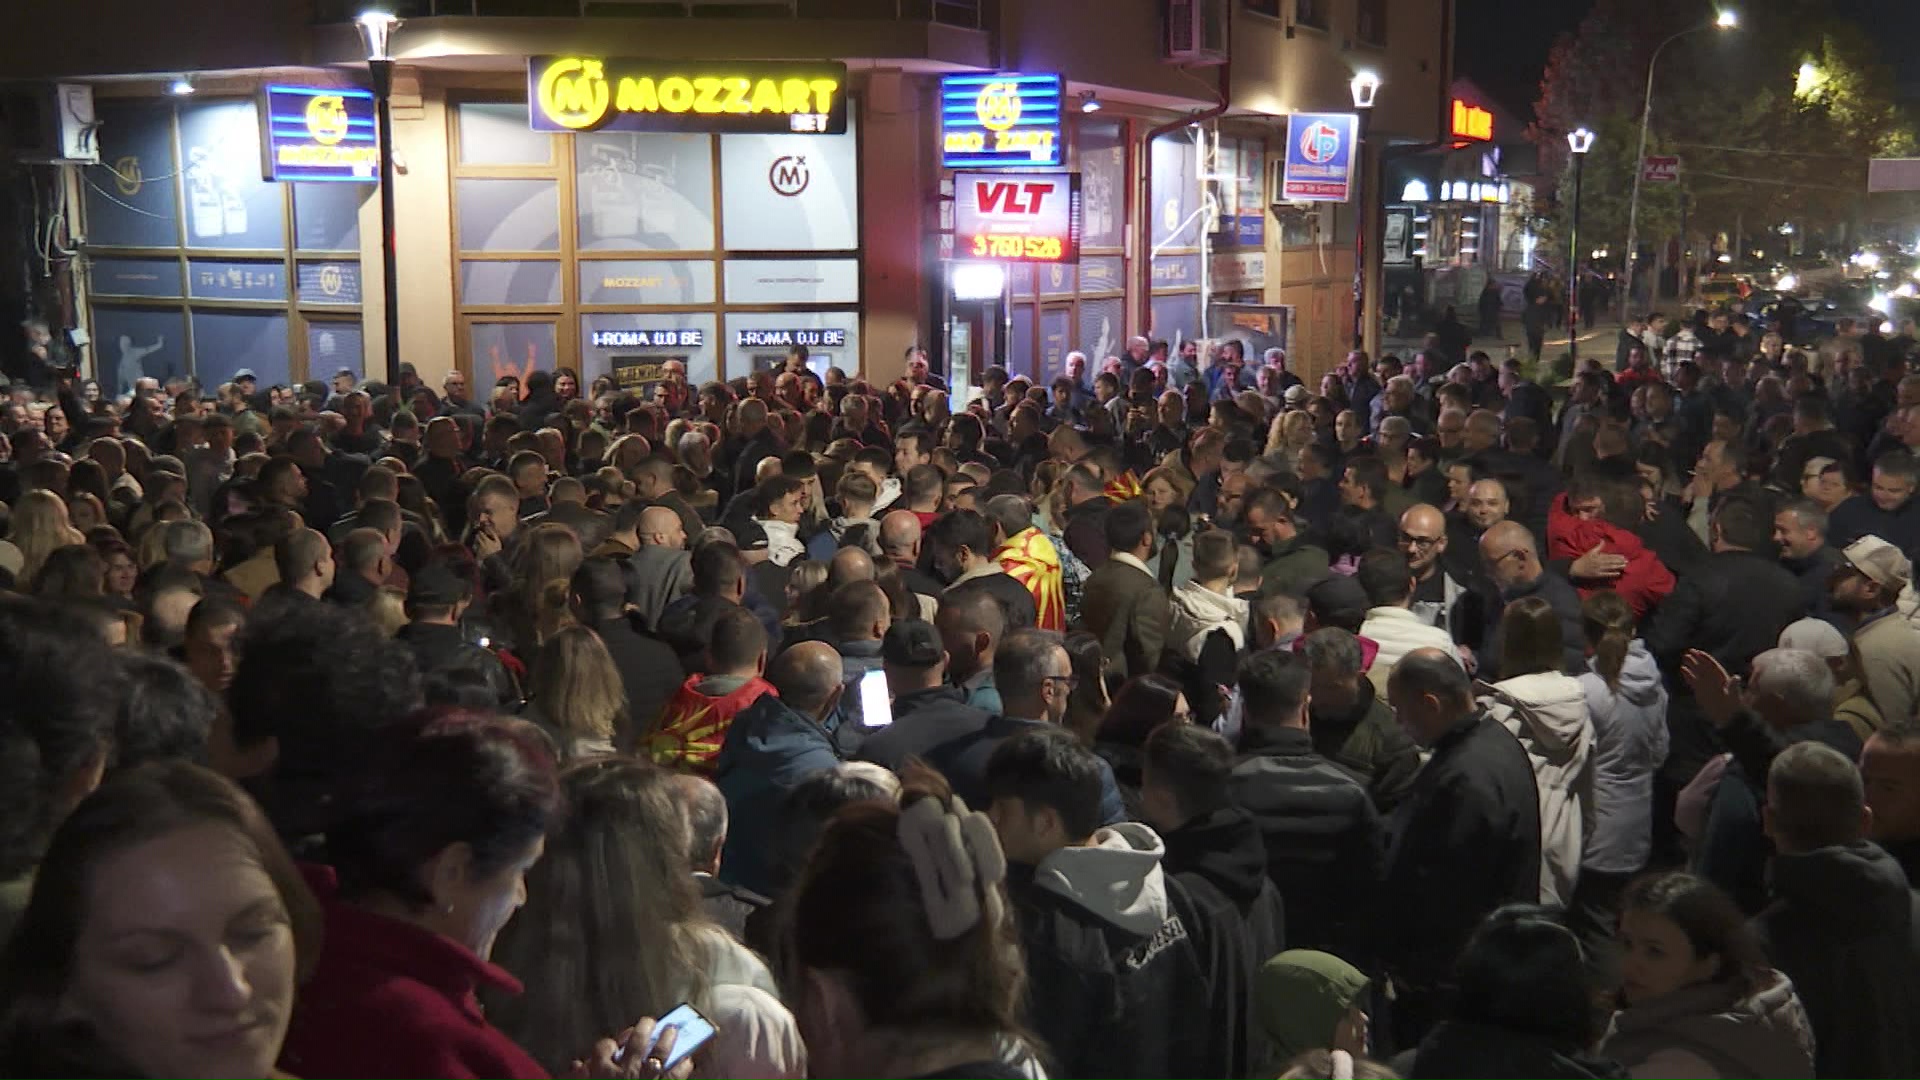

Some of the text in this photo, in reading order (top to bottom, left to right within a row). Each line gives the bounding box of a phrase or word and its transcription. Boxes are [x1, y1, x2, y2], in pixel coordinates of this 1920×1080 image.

[616, 77, 837, 113] MOZZART
[976, 181, 1054, 214] VLT
[973, 235, 987, 257] 3
